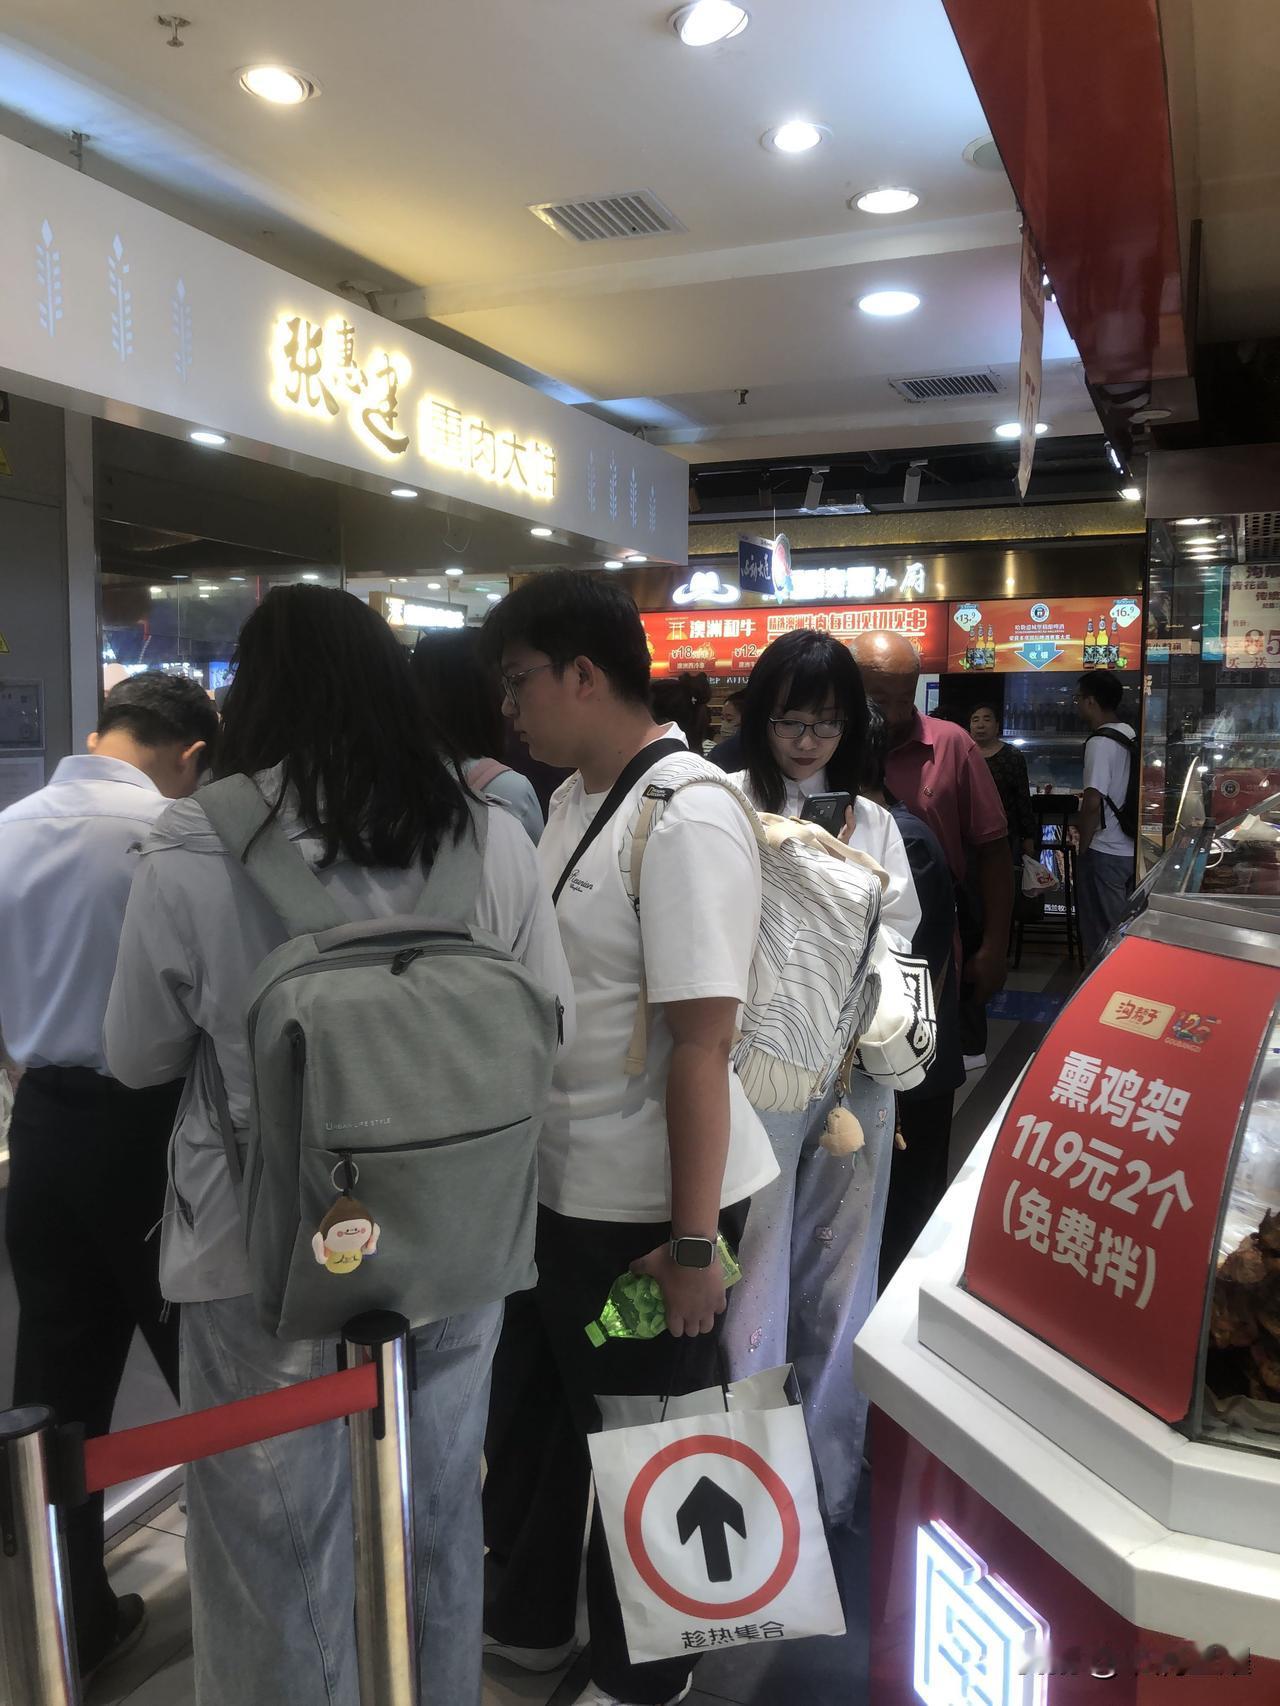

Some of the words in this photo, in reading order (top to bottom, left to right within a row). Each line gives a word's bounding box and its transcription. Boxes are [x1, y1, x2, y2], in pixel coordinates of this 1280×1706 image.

[690, 619, 757, 638] 澳洲和牛
[1115, 1000, 1161, 1026] 沟帮子
[1049, 1051, 1192, 1146] 熏鸡架
[1011, 1114, 1194, 1230] 11.9元2个
[680, 1620, 785, 1649] 趁热集合
